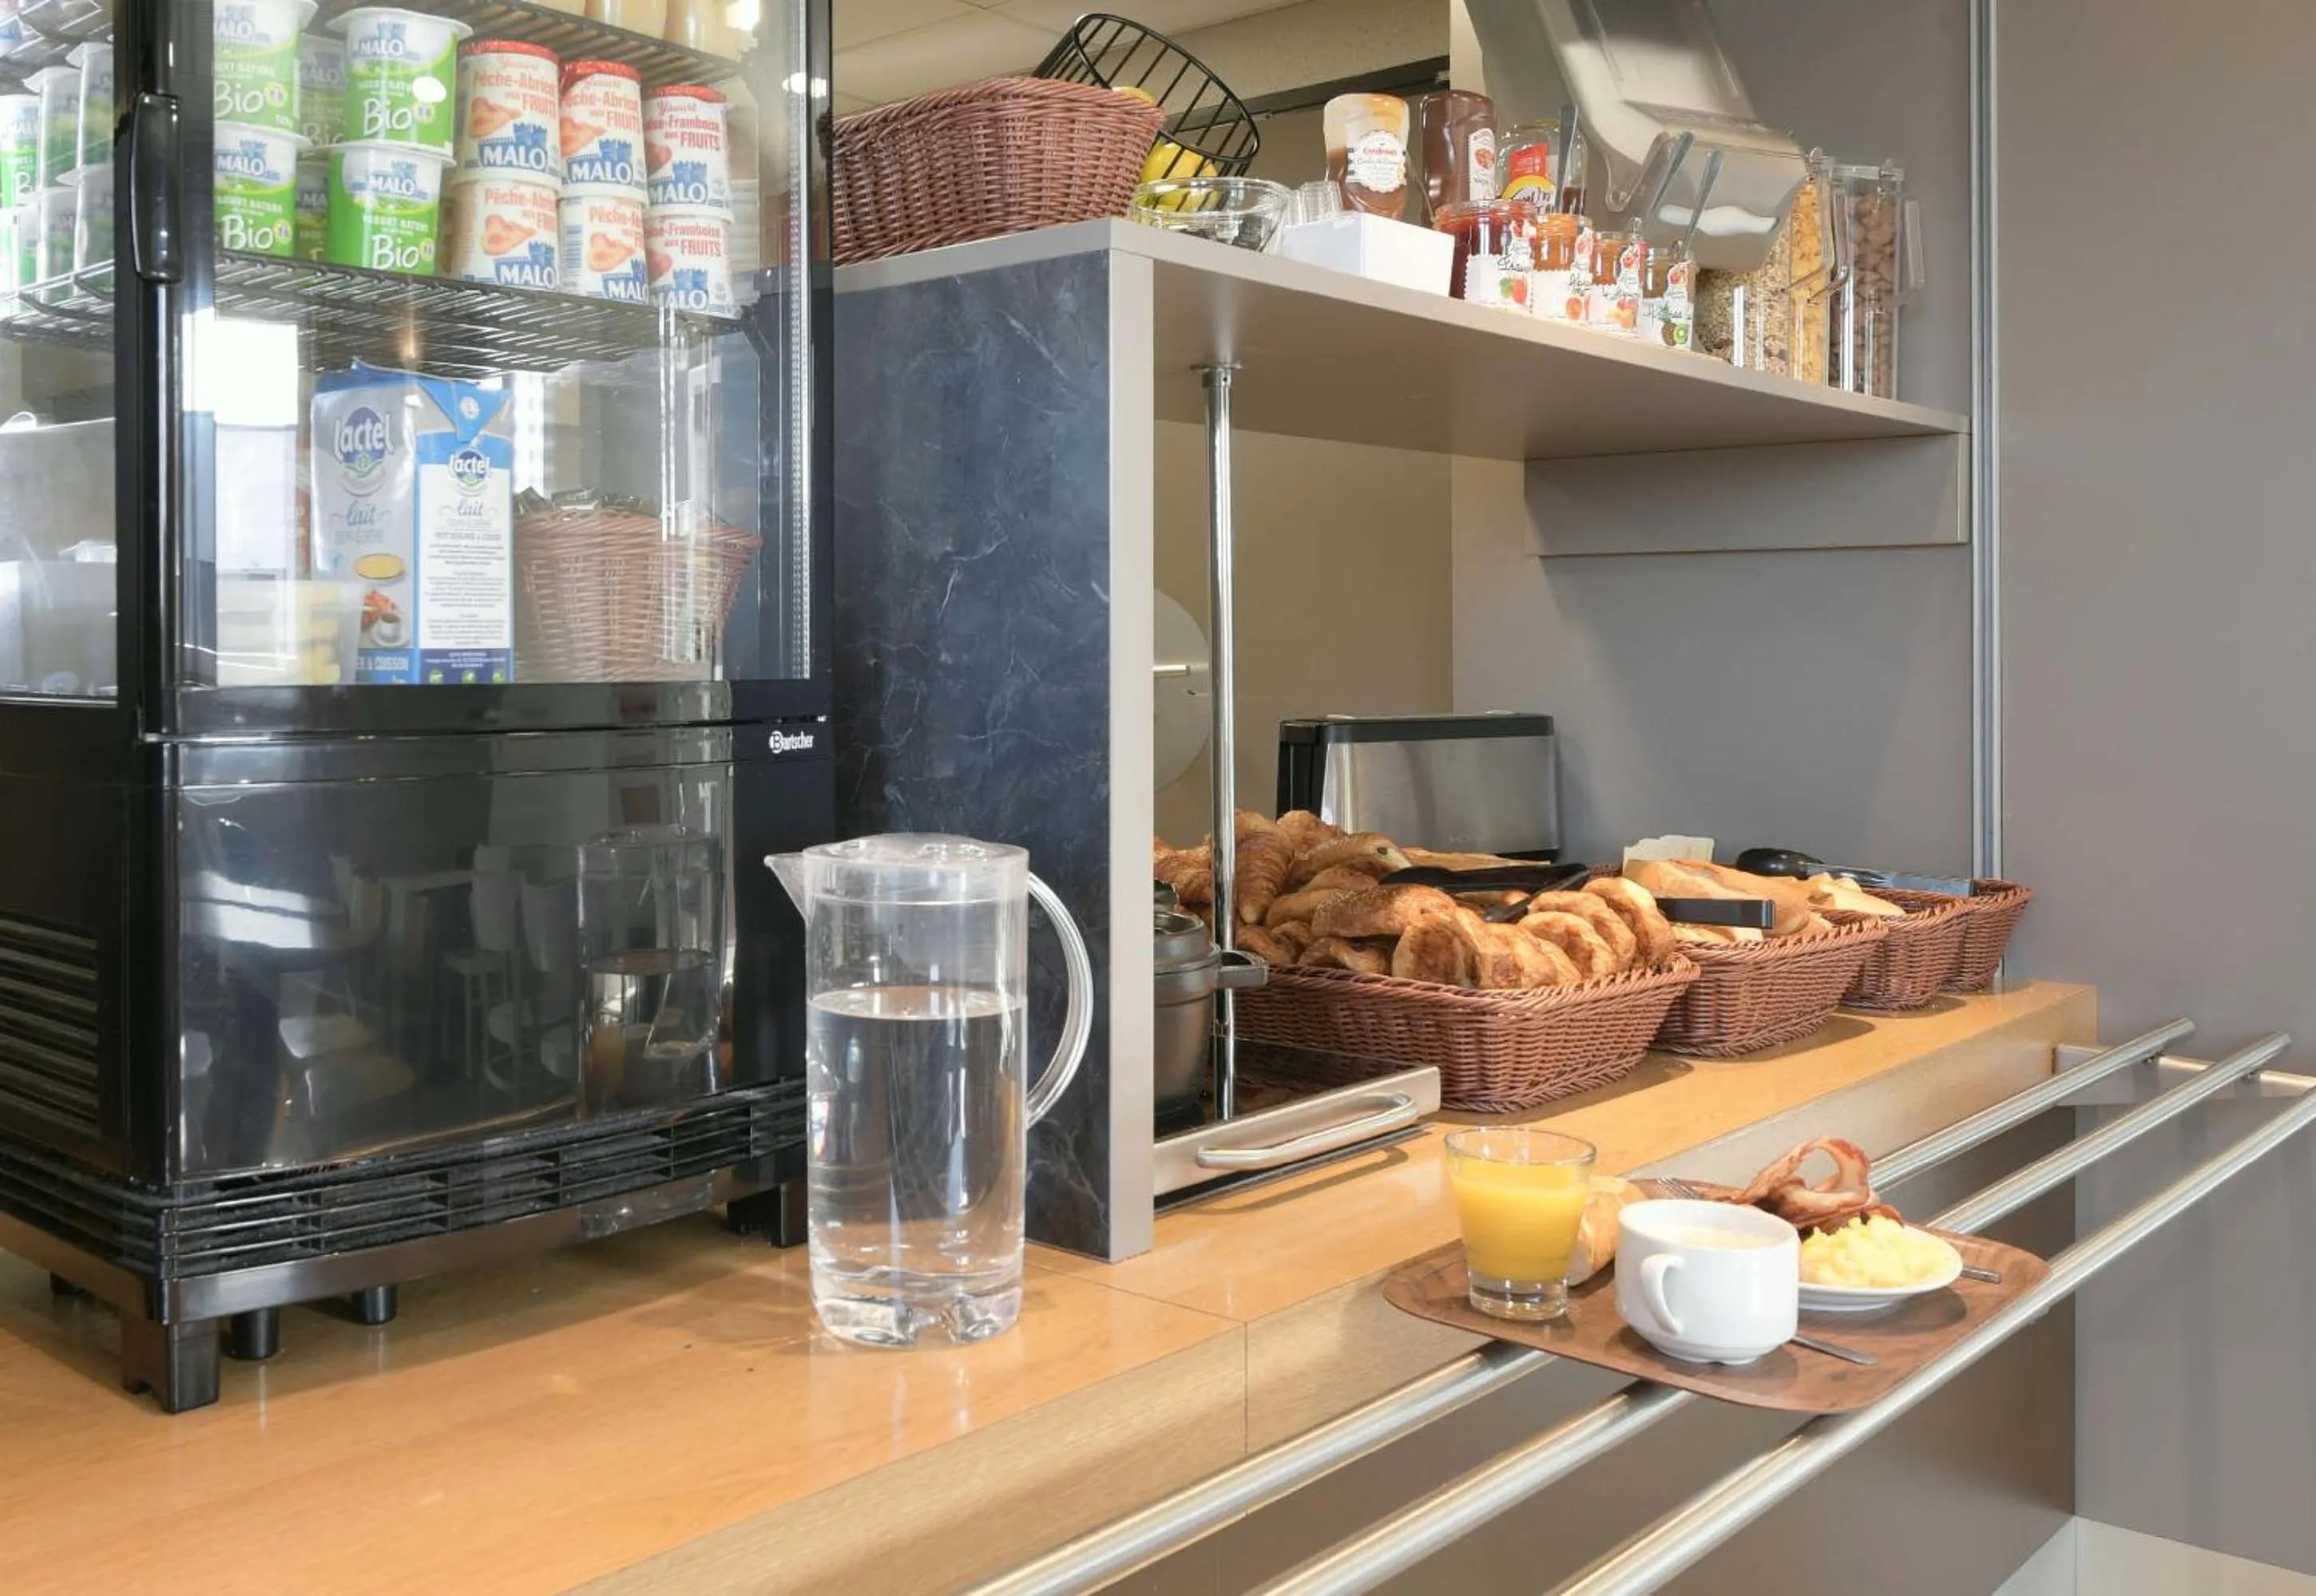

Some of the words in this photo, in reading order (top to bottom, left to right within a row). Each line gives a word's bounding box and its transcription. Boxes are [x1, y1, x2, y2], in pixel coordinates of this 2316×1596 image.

[360, 38, 403, 55] MALO
[214, 81, 264, 118] Bio
[363, 98, 412, 137] Bio
[680, 131, 720, 151] FRUITS
[216, 155, 264, 176] MALO
[482, 145, 547, 171] MALO
[571, 160, 633, 184] MALO
[370, 175, 415, 195] MALO
[649, 181, 707, 204] MALO
[303, 192, 327, 207] MA
[221, 214, 275, 249] Bio
[371, 234, 419, 270] Bio
[681, 240, 722, 257] FRUITS
[500, 264, 556, 290] MALO
[607, 280, 648, 303] MALO
[334, 412, 395, 464] lactel
[449, 453, 491, 477] lactel
[347, 499, 377, 526] lait
[457, 498, 485, 517] lait
